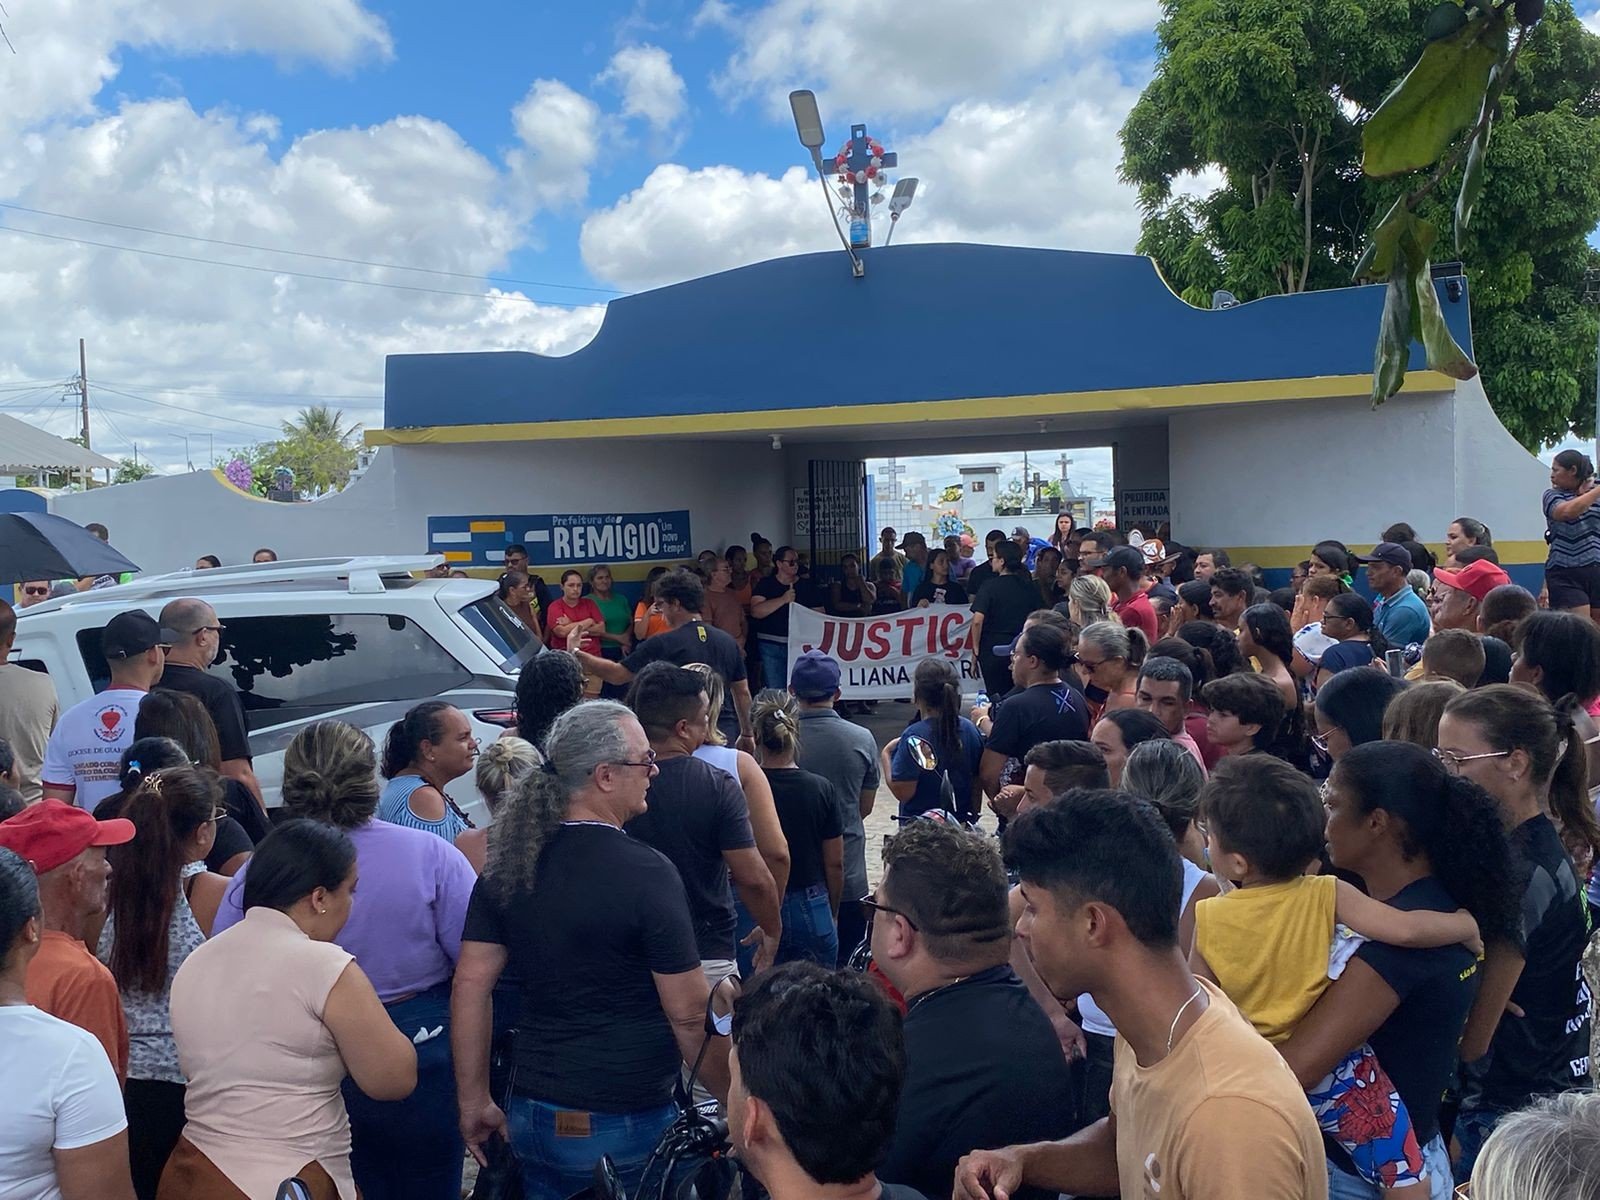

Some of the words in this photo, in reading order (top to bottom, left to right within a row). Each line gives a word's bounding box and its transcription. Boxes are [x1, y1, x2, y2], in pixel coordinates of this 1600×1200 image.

[1132, 505, 1169, 516] ENTRADA
[552, 515, 603, 526] Prefeitura
[553, 516, 660, 560] REMÍGIO
[849, 666, 911, 687] LIANA
